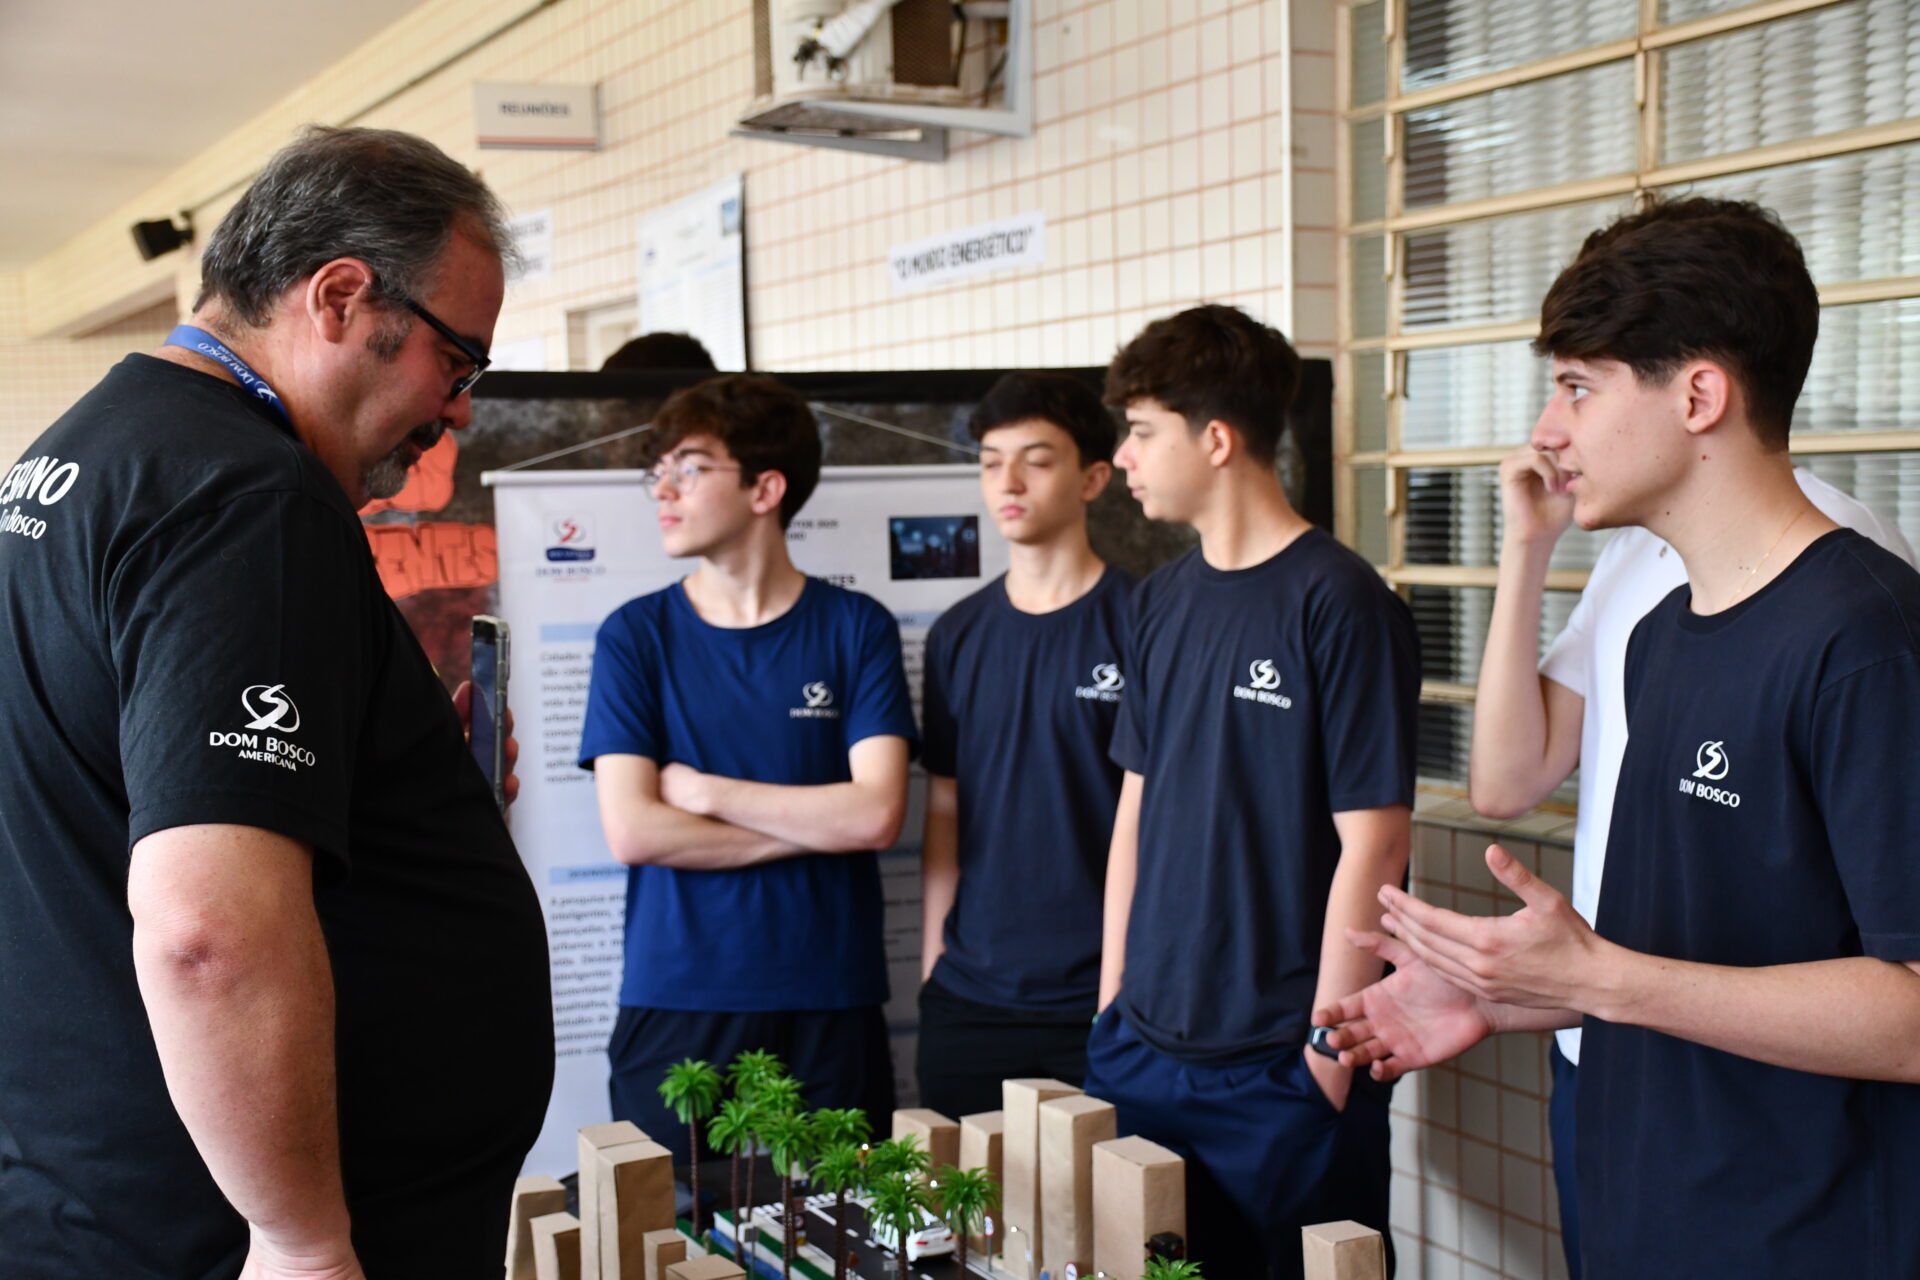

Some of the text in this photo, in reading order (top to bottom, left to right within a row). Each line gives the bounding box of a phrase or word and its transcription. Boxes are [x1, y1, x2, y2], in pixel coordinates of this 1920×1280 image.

[1234, 685, 1292, 710] DOM BOSCO
[209, 731, 316, 767] DOM BOSCO
[238, 749, 297, 772] AMERICANA
[1679, 778, 1741, 808] DOM BOSCO
